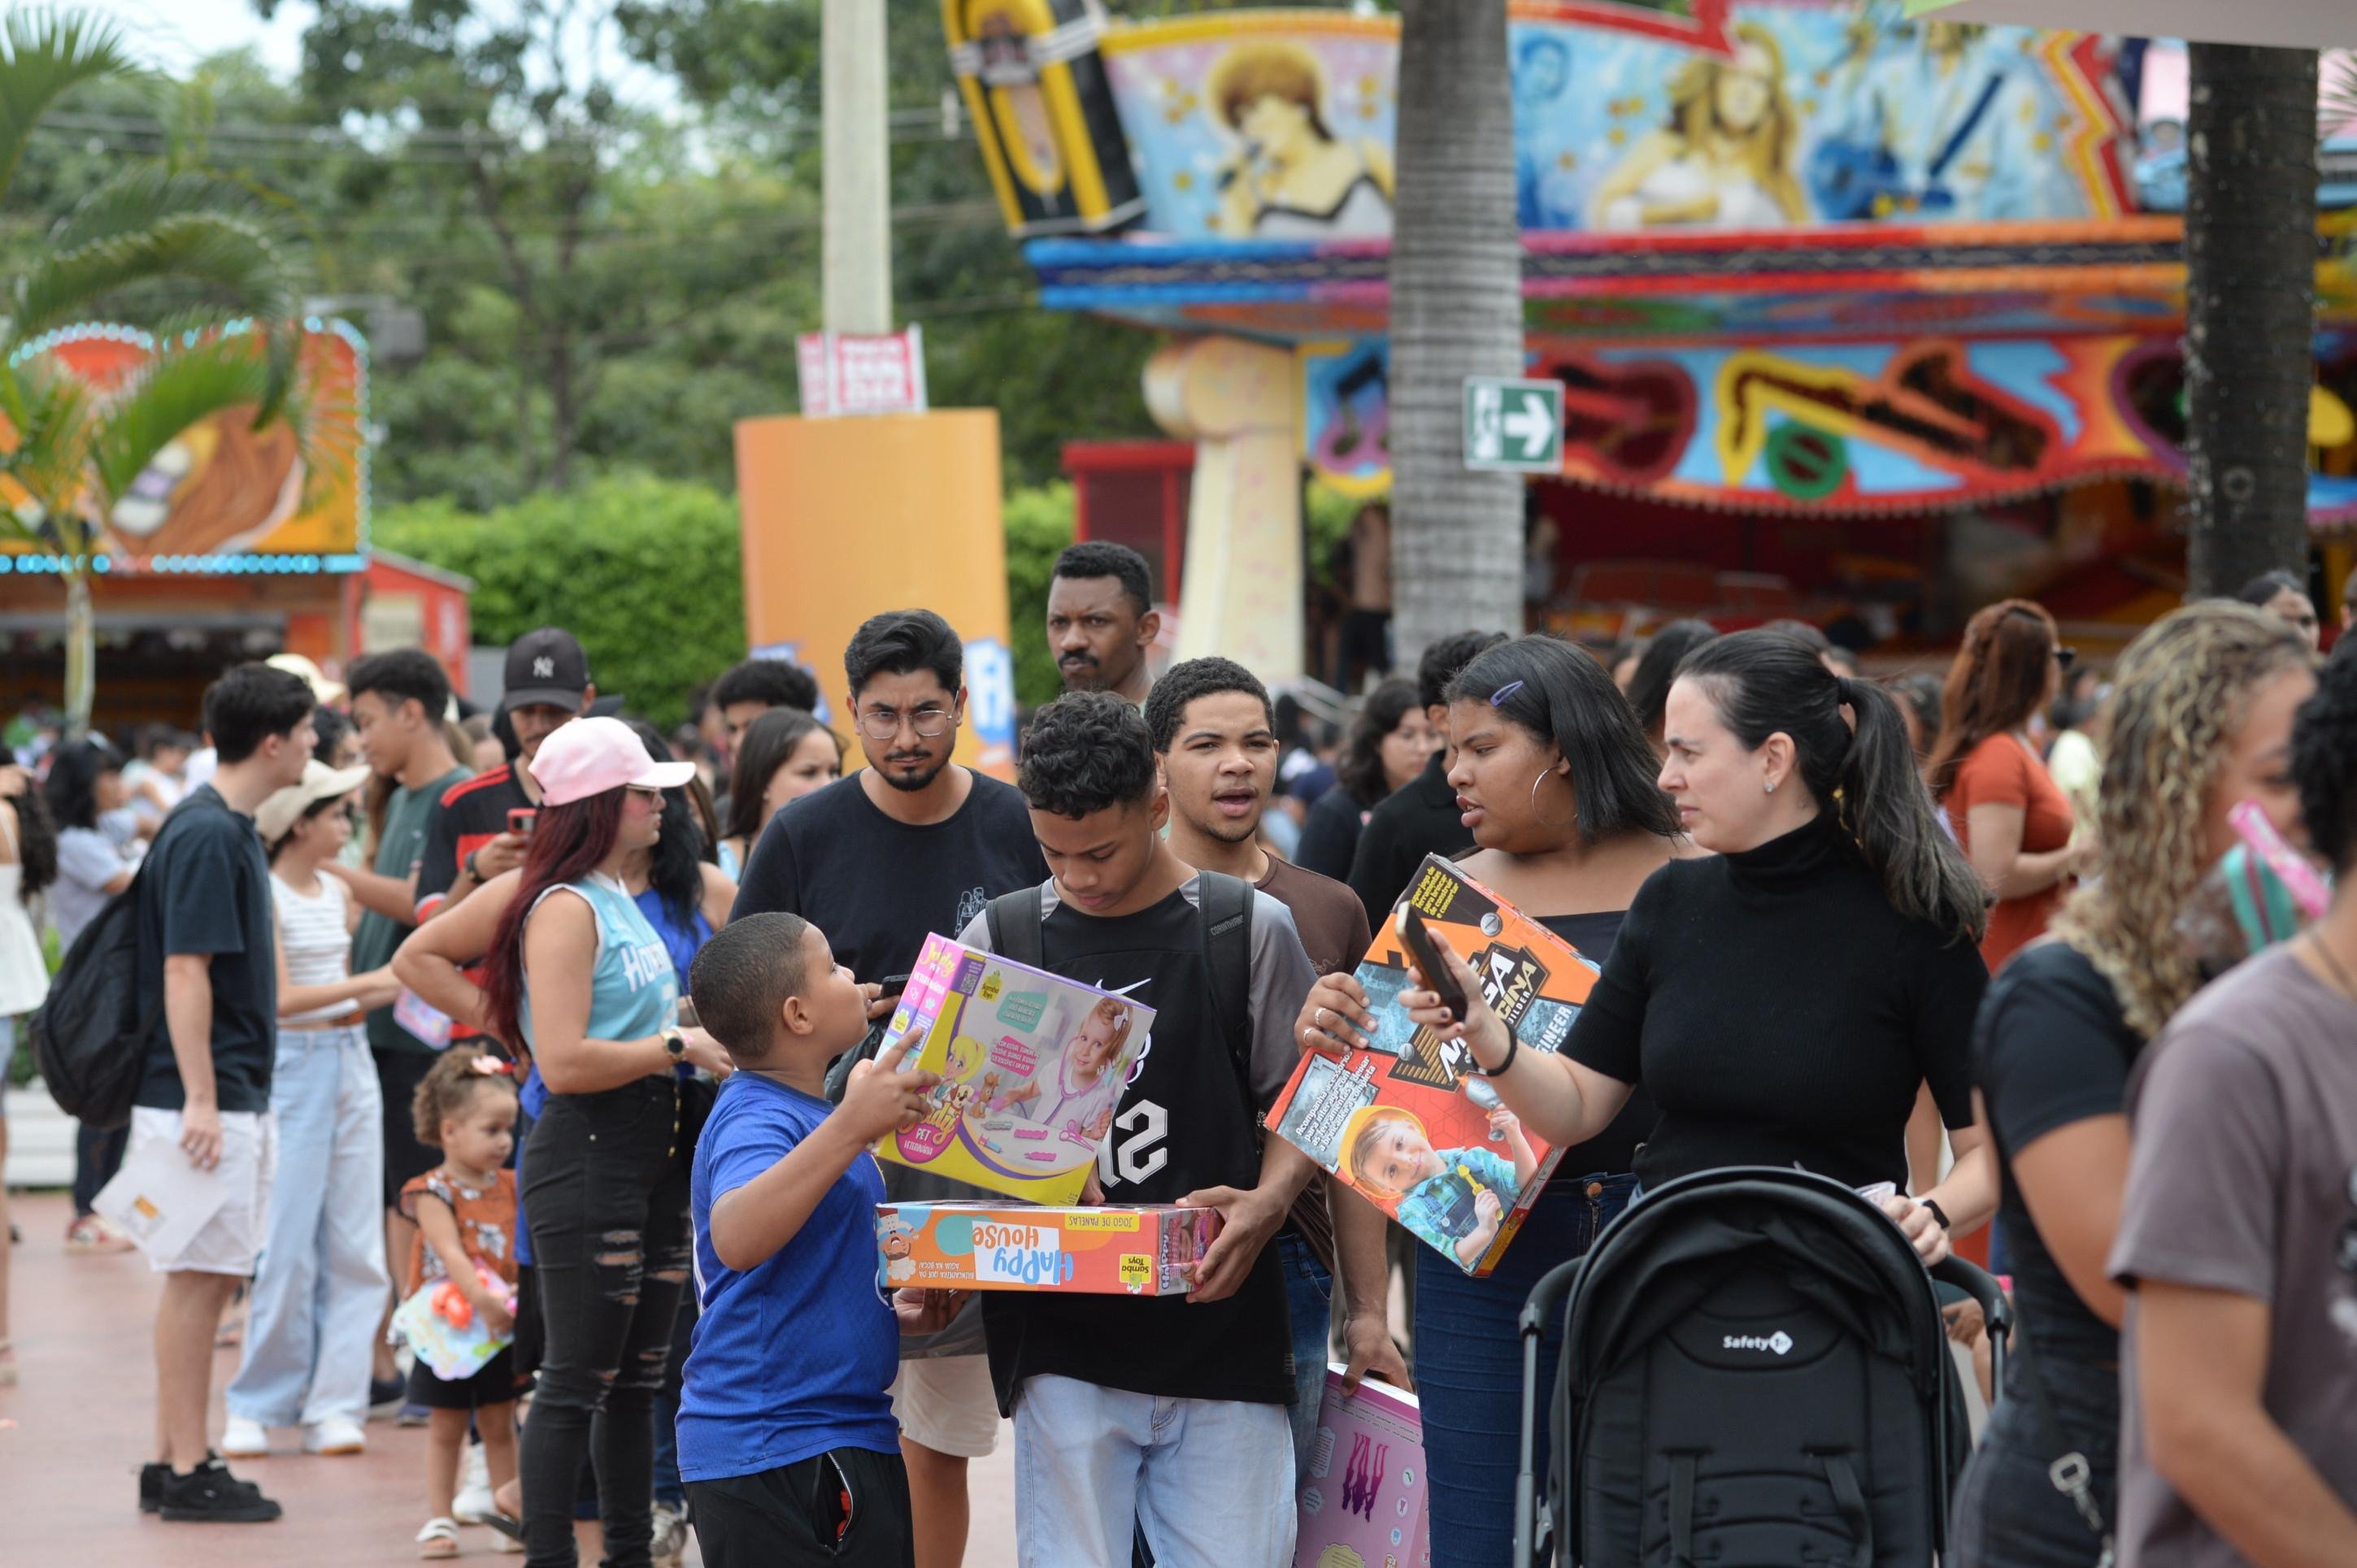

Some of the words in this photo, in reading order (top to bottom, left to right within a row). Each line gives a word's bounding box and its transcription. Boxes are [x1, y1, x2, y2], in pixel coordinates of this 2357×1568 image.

[1425, 864, 1436, 875] de
[1414, 869, 1442, 909] ferramentas
[1422, 896, 1435, 913] para
[1429, 873, 1448, 897] brincar
[1428, 906, 1437, 915] de
[1433, 877, 1454, 907] construir
[1438, 882, 1459, 914] consertar
[981, 982, 999, 994] Samba
[981, 989, 993, 1000] Toys
[1350, 1054, 1372, 1082] deixar
[1302, 1120, 1320, 1142] para
[1314, 1085, 1343, 1123] interagir
[1336, 1069, 1351, 1088] com
[1315, 1086, 1352, 1136] ferramentas
[1320, 1099, 1355, 1145] brincadeira
[1348, 1063, 1377, 1102] completa
[1294, 1089, 1329, 1137] Acompanha
[915, 1127, 932, 1141] PET
[1311, 1135, 1322, 1147] as
[1068, 1215, 1098, 1227] PANELAS
[1101, 1217, 1110, 1227] DE
[1113, 1216, 1132, 1227] JOGO
[1128, 1256, 1144, 1266] Toys
[928, 1270, 937, 1278] QUE
[1120, 1265, 1149, 1274] Samba
[1723, 1334, 1769, 1351] Safety
